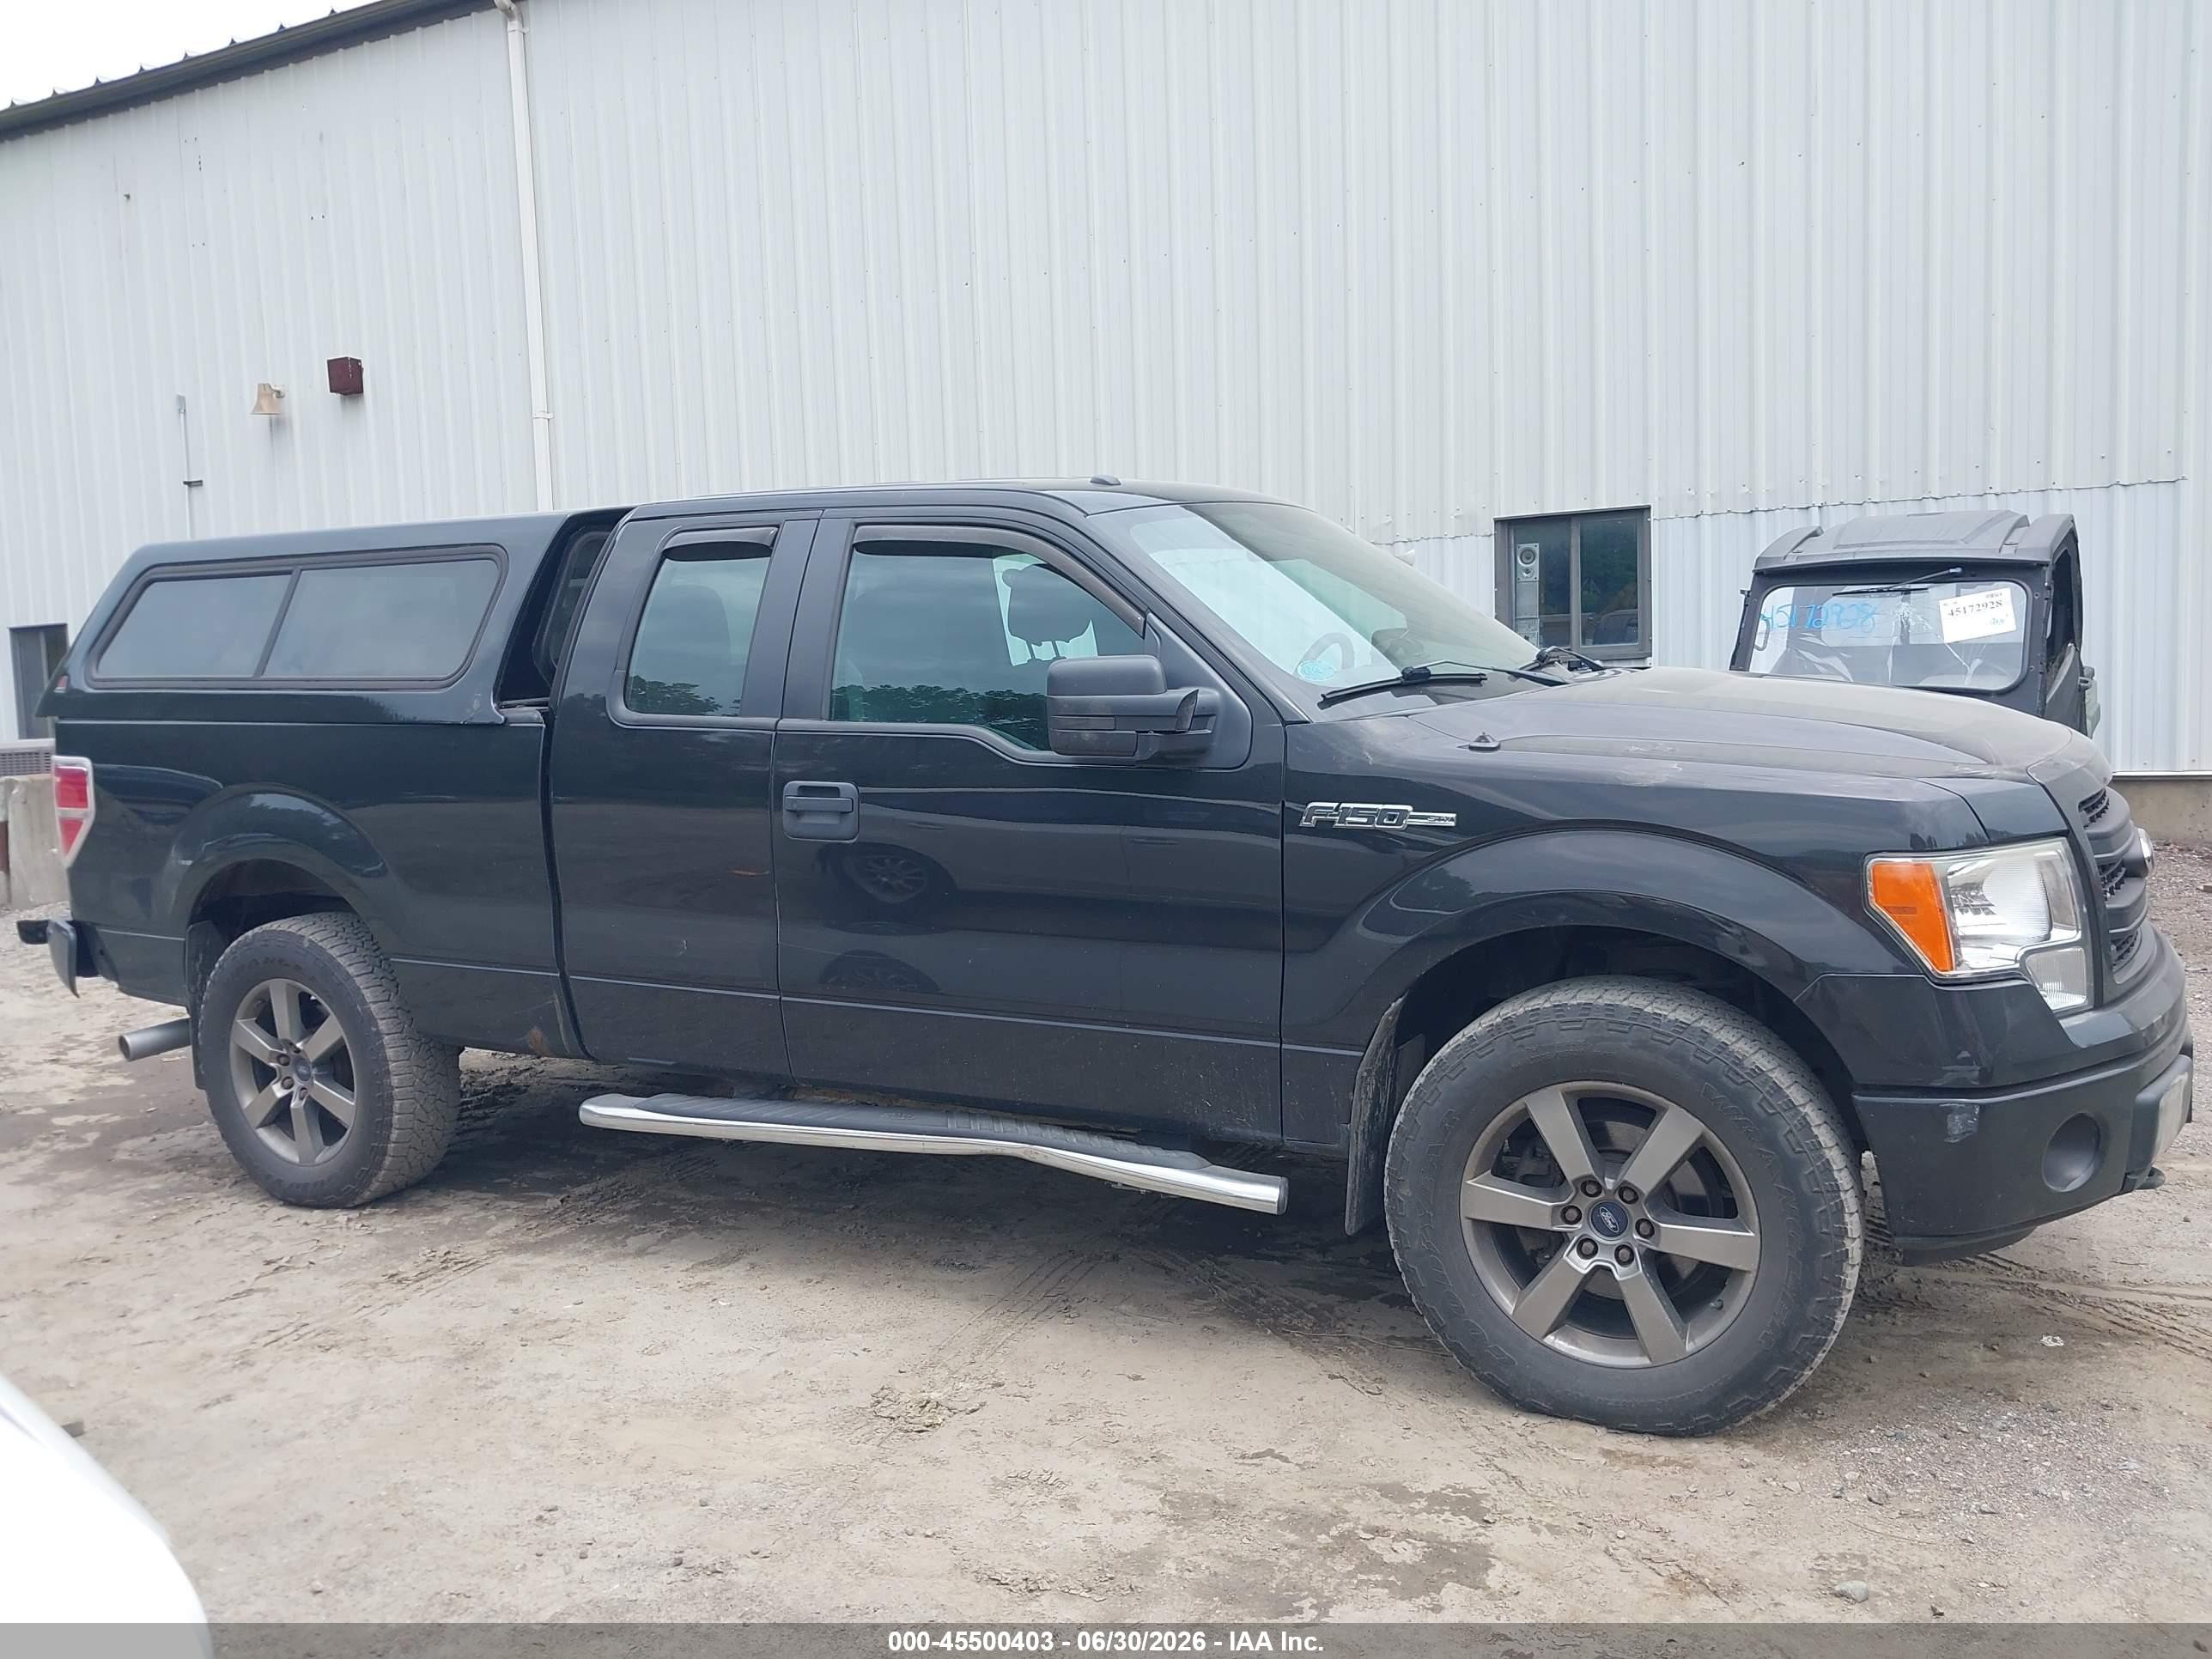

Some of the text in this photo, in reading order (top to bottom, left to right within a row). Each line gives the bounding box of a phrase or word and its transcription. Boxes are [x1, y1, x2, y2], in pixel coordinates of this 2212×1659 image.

[1948, 599, 2003, 617] 45172928
[1299, 802, 1413, 830] F-150
[1601, 1210, 1618, 1230] Ford
